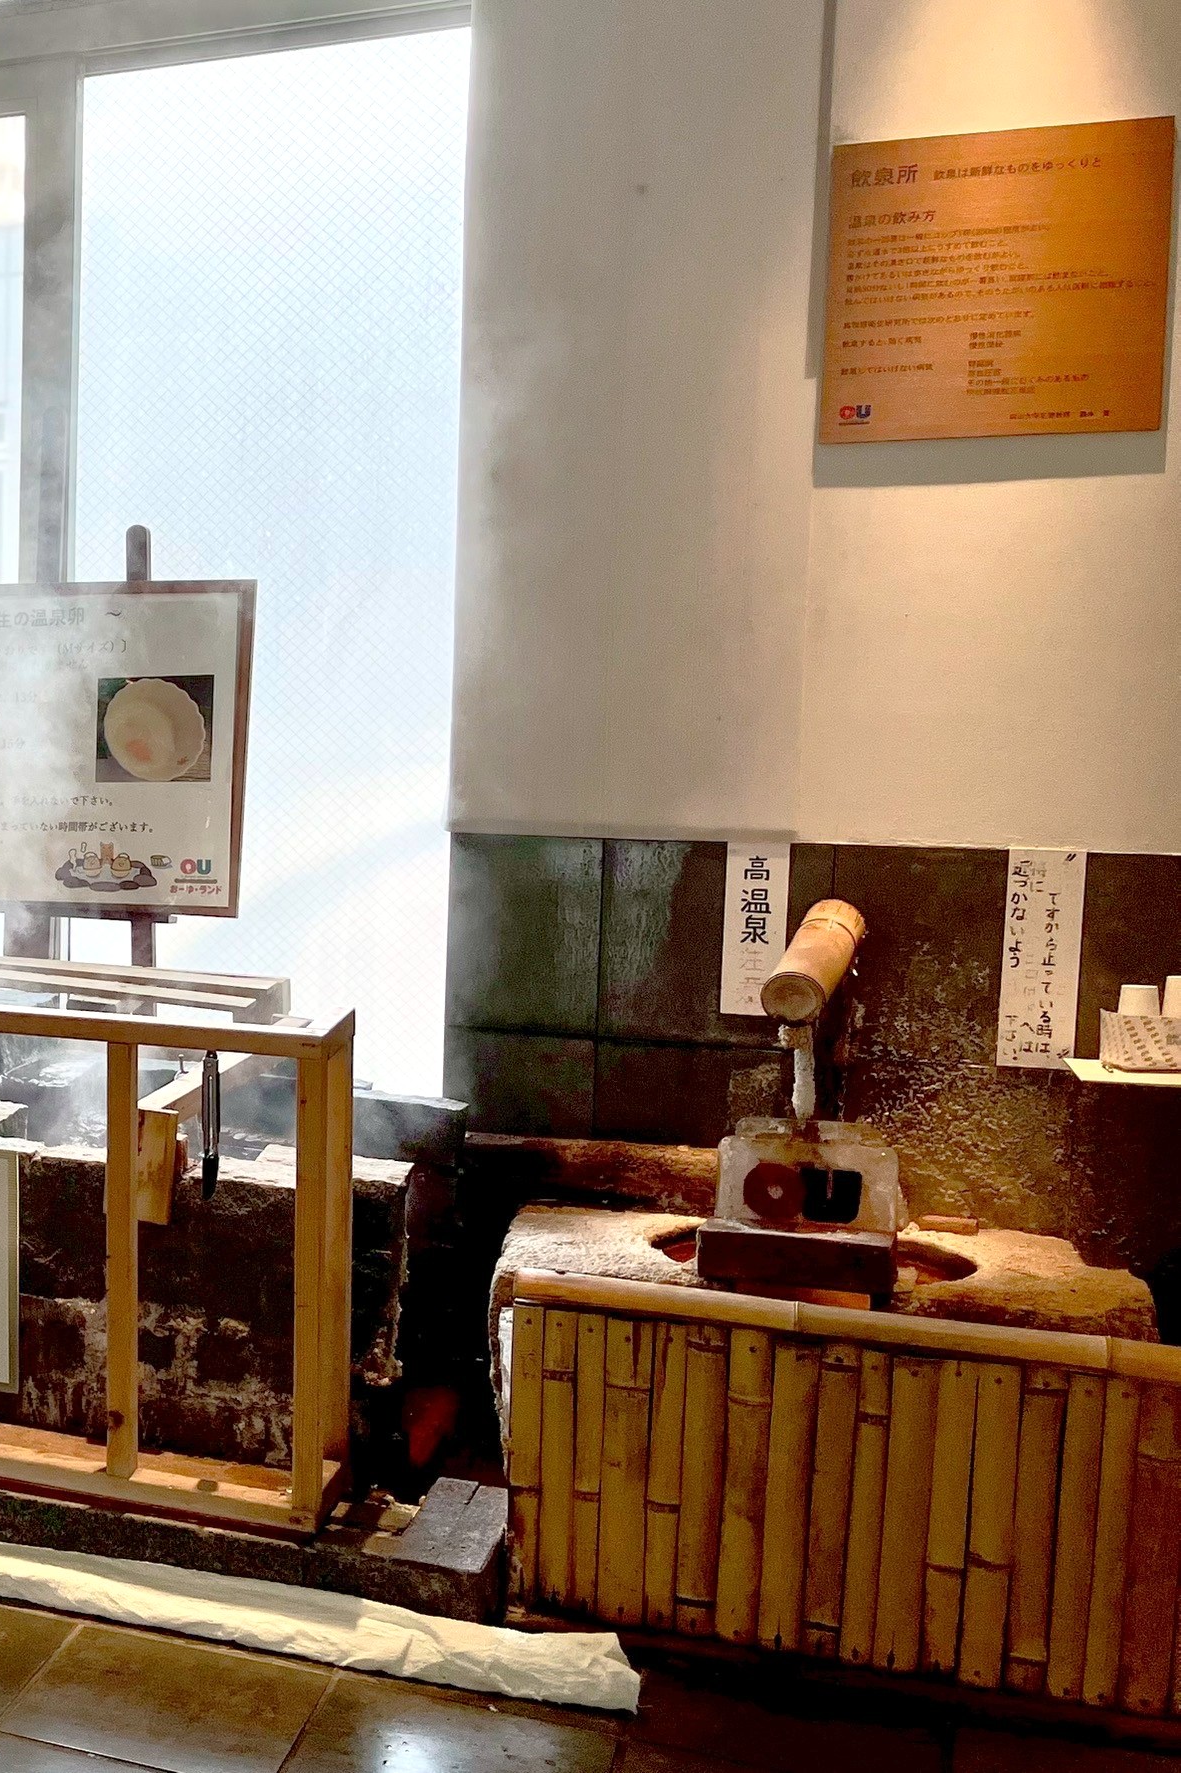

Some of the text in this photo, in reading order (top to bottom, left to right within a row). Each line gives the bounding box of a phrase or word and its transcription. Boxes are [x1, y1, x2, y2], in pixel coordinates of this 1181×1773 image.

[848, 210, 936, 229] 温泉の飲み方
[839, 404, 872, 421] OU
[180, 858, 212, 875] OU
[169, 884, 223, 895] おーゆ・ランド
